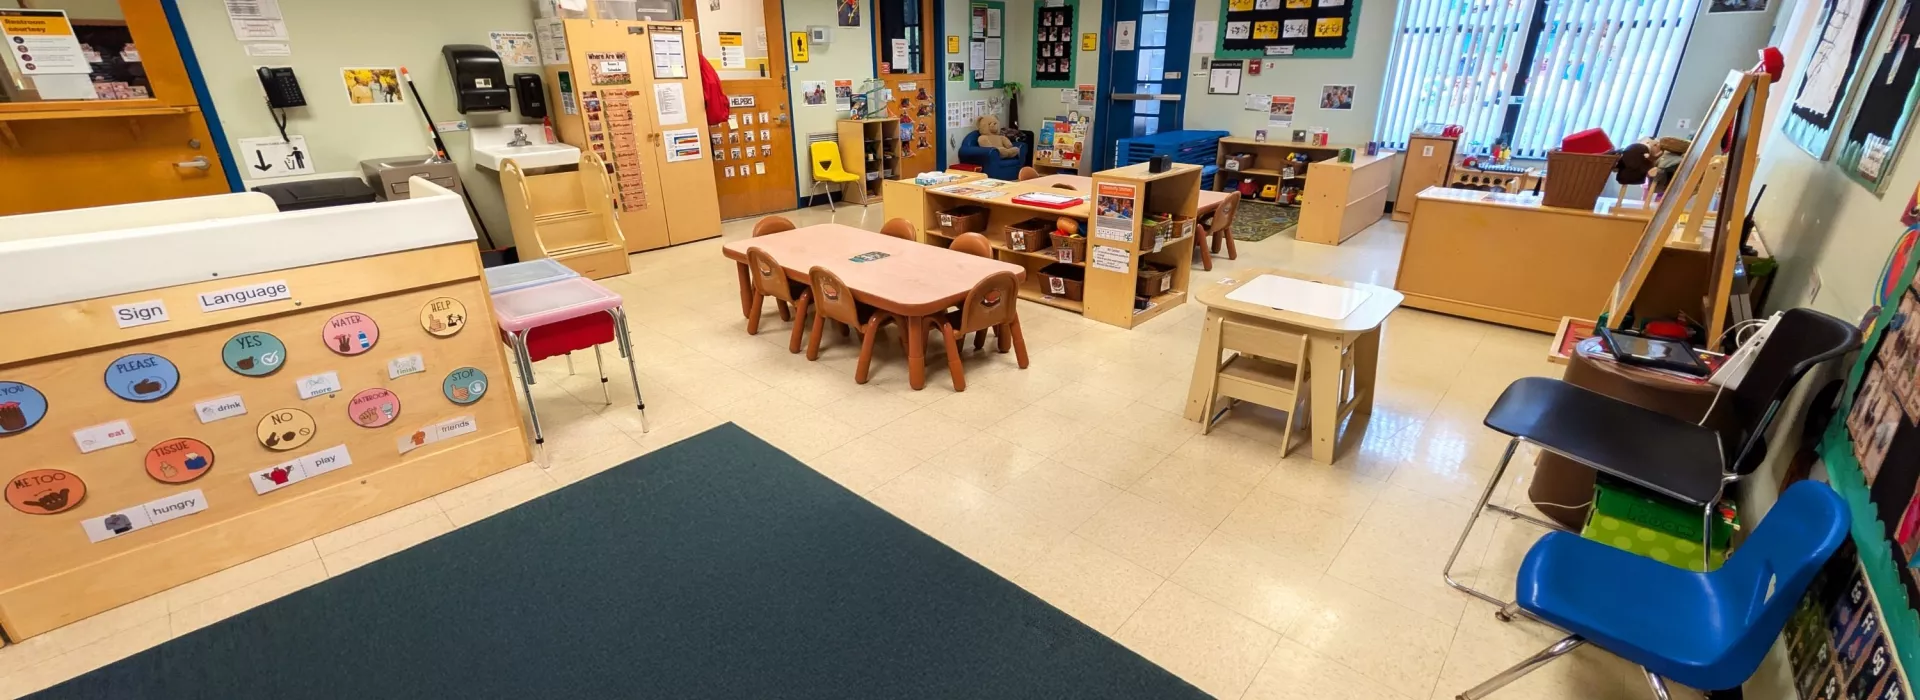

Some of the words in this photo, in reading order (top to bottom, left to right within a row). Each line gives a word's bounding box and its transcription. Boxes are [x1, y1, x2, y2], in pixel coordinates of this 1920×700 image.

[731, 97, 753, 106] HELPERS
[118, 304, 164, 321] Sign
[201, 282, 287, 307] Language
[431, 300, 451, 313] HELP
[331, 315, 362, 329] WATER
[236, 335, 262, 350] YES
[116, 357, 158, 374] PLEASE
[451, 368, 475, 381] STOP
[1, 385, 24, 396] YOU
[310, 387, 332, 396] more
[217, 401, 241, 412] drink
[271, 411, 293, 426] NO
[441, 420, 470, 433] friends
[108, 428, 125, 439] eat
[154, 440, 190, 458] TISSUE
[315, 454, 336, 467] play
[14, 476, 30, 490] ME
[30, 472, 66, 486] TOO
[152, 497, 196, 516] hungry
